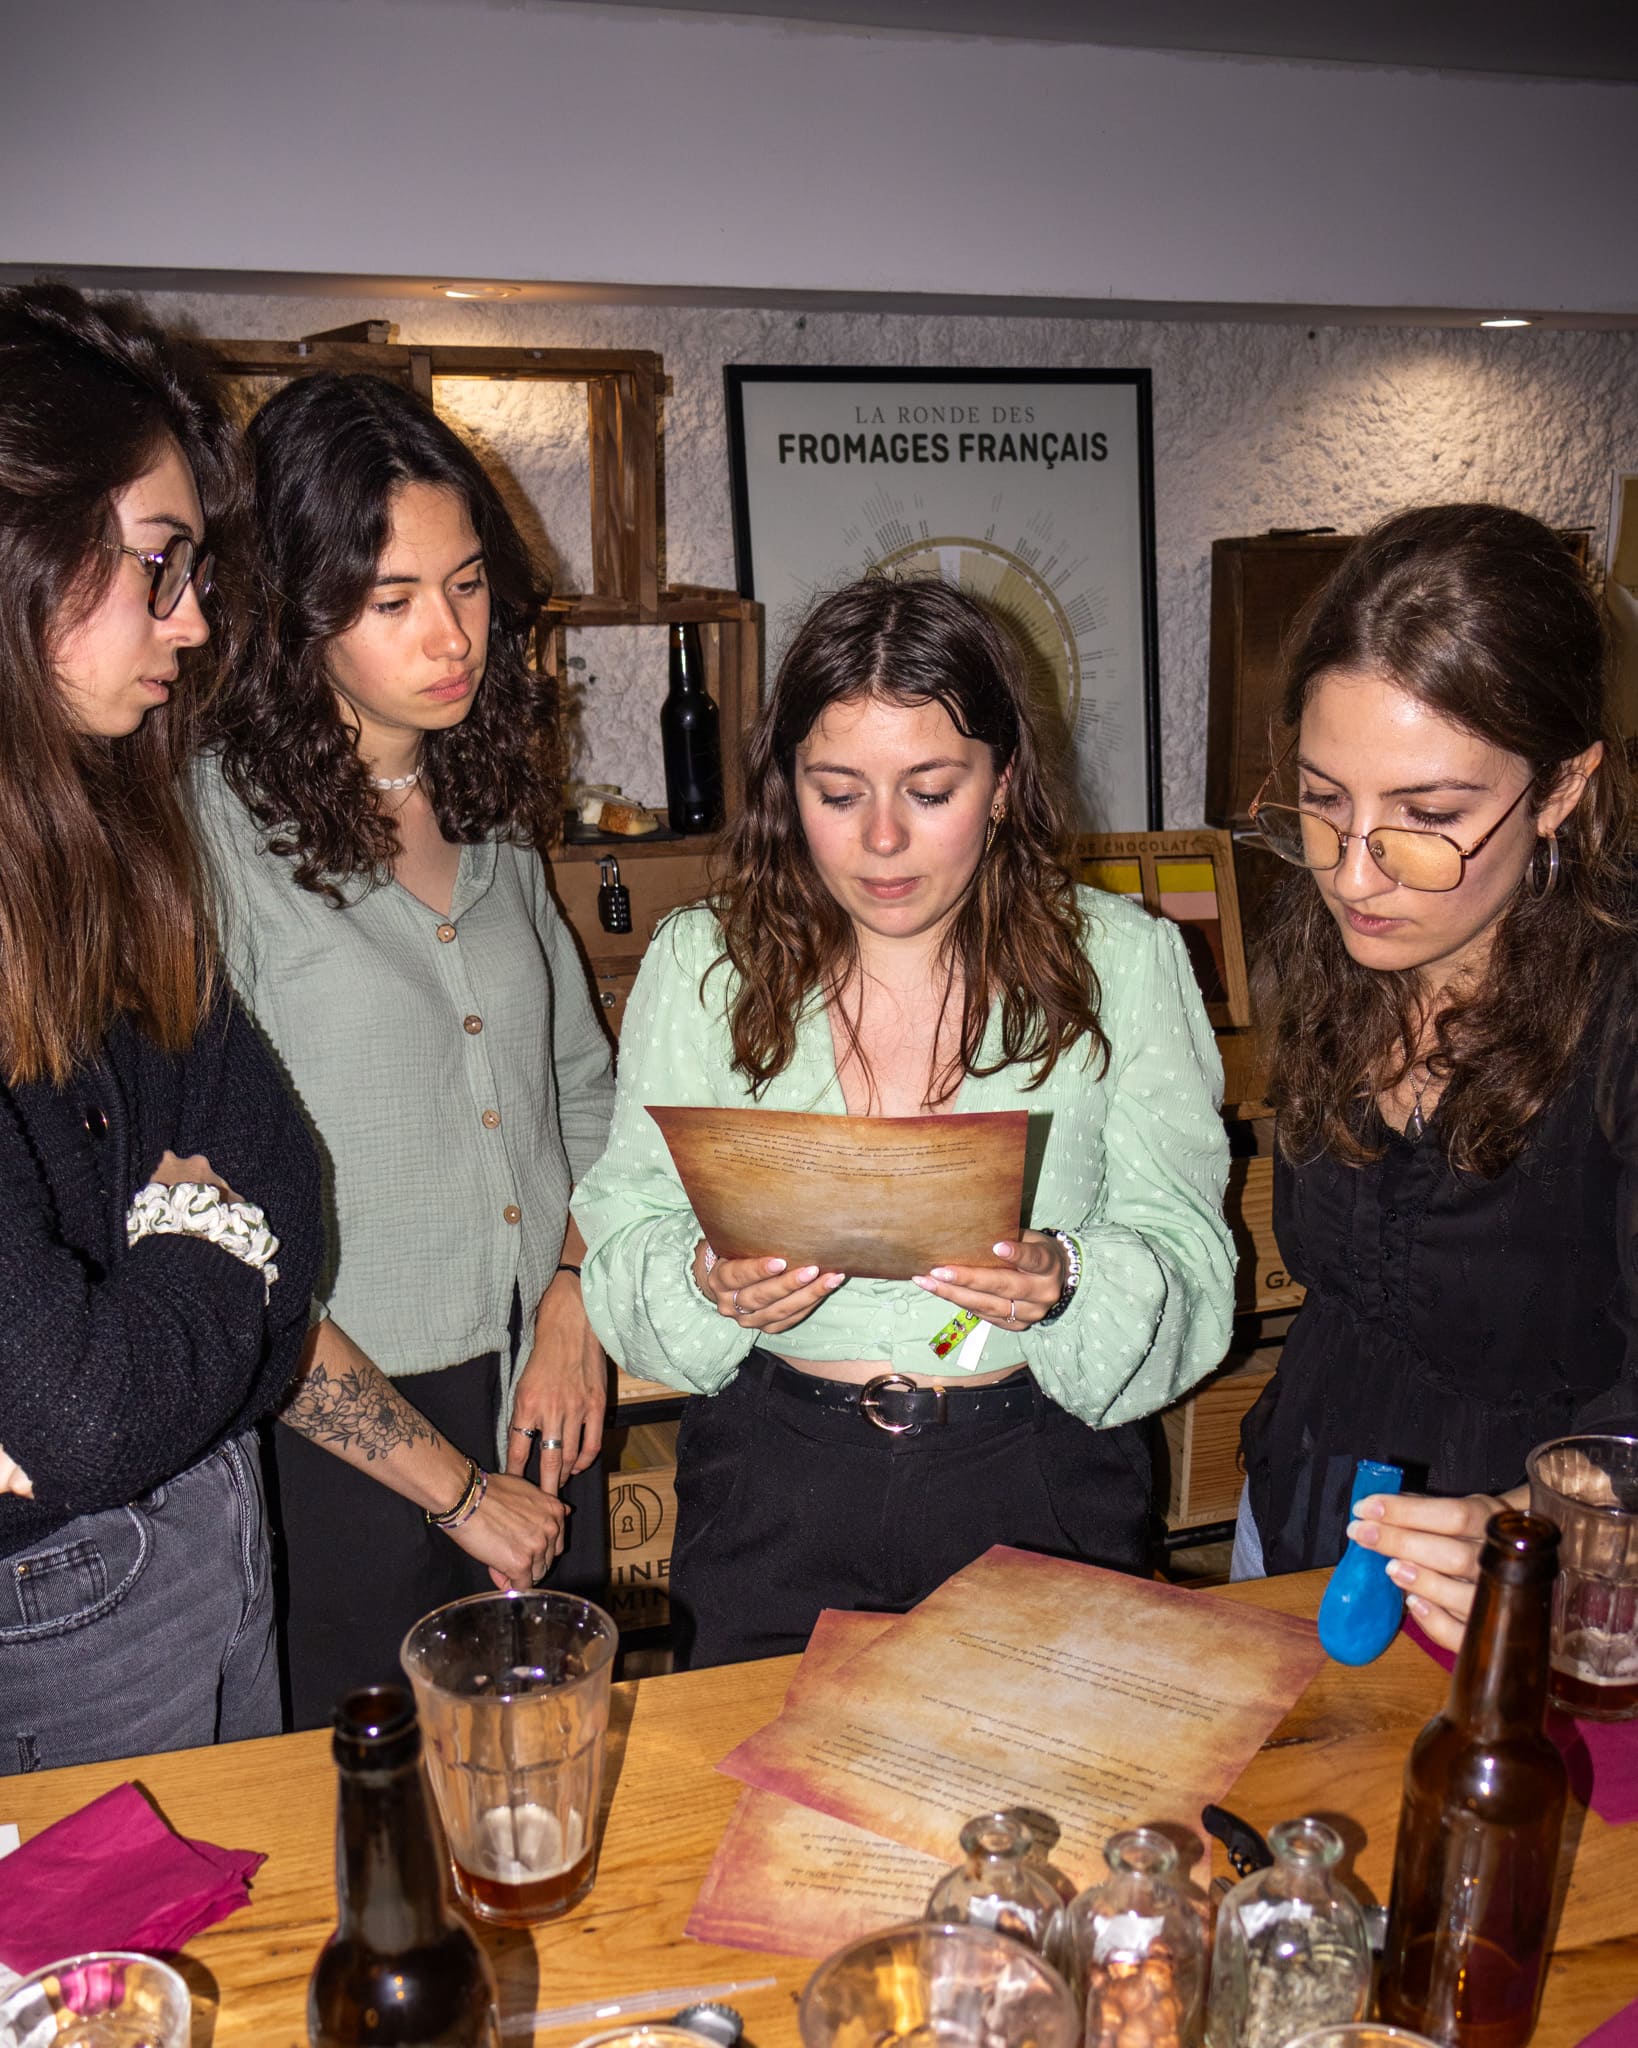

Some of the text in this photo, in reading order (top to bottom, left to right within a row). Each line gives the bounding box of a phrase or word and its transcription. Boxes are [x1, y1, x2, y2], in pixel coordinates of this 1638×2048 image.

[855, 406, 1035, 424] LA RONDE DES
[778, 432, 1108, 470] FROMAGES FRANÇAIS
[1104, 840, 1188, 853] CHOCOLAT
[609, 1558, 671, 1585] INE
